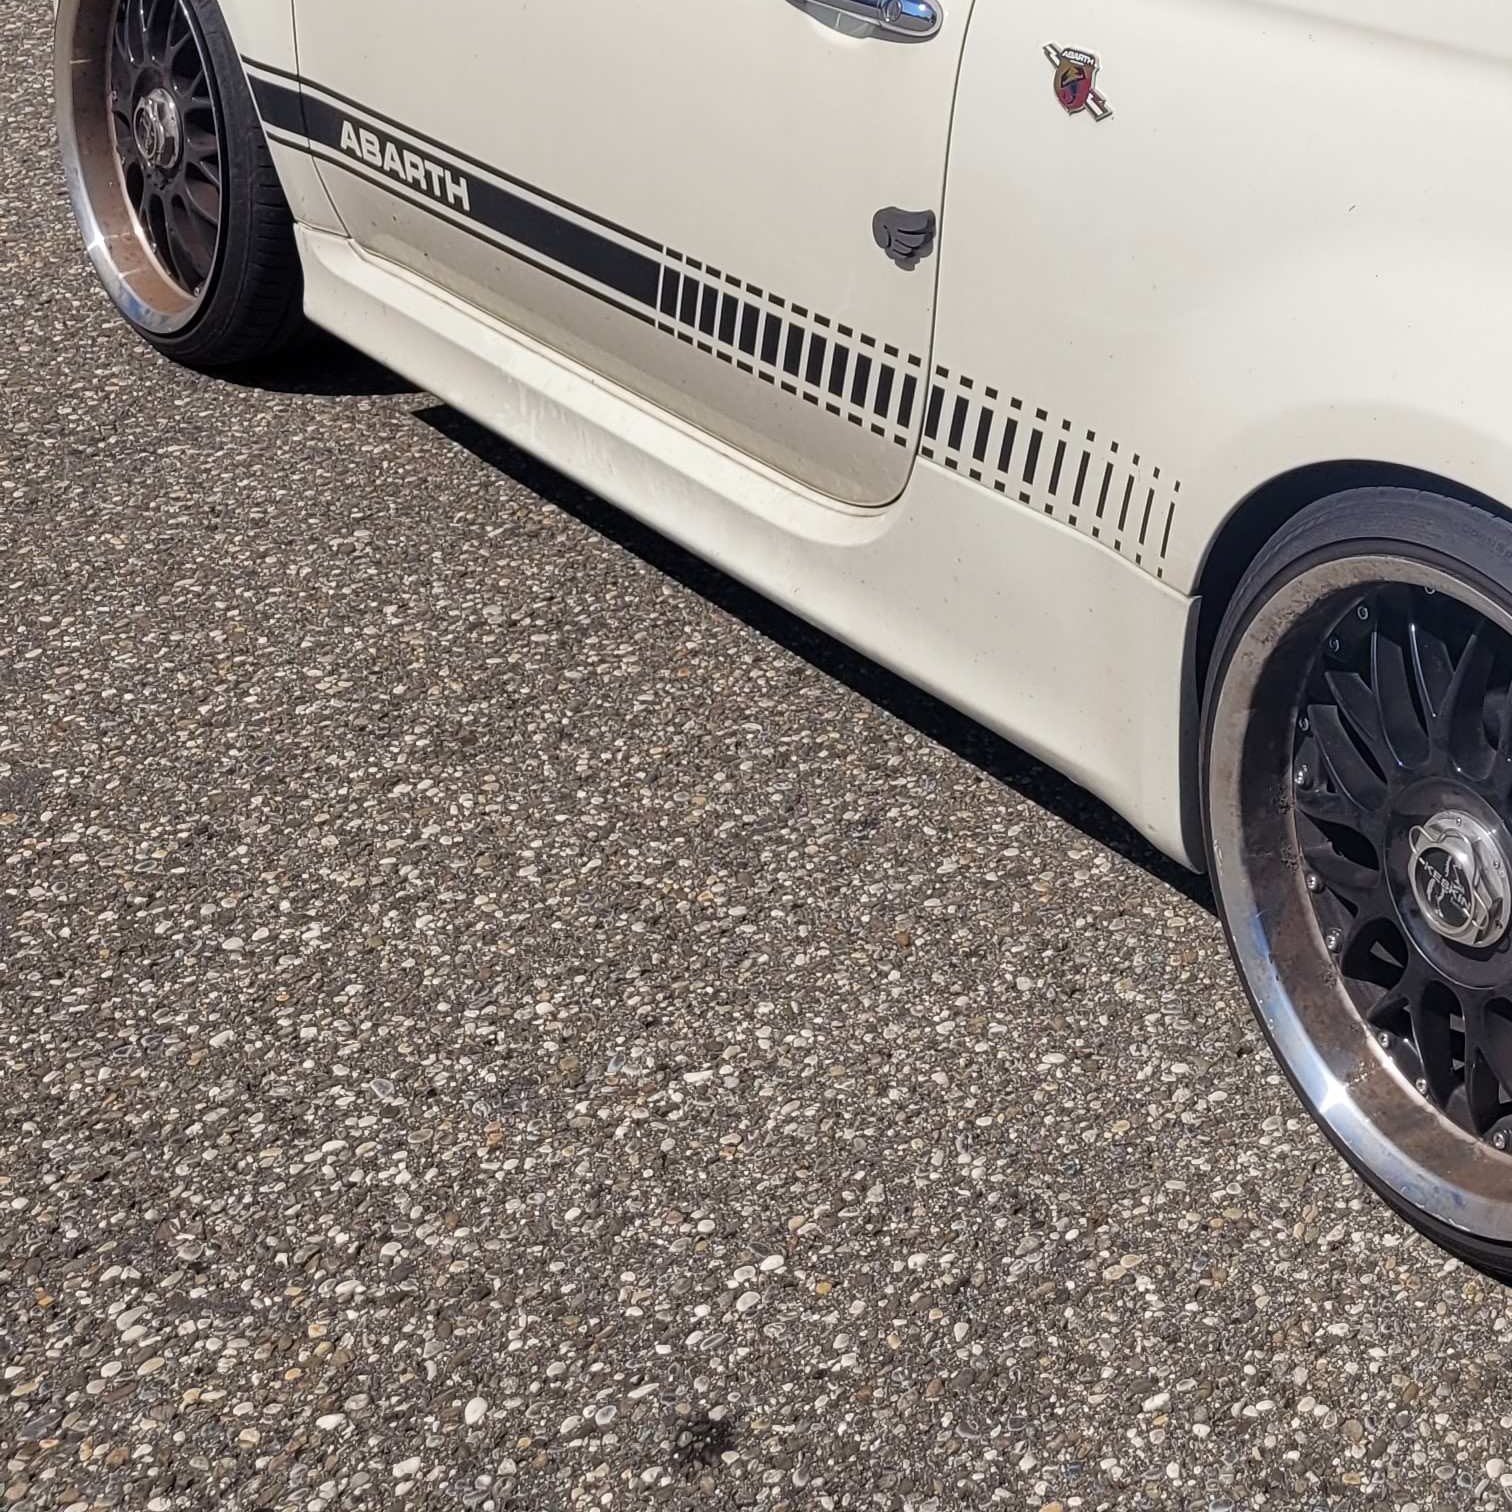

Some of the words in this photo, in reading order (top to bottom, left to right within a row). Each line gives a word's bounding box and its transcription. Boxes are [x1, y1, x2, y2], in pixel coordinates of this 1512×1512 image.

[1062, 50, 1094, 65] ABARTH
[340, 120, 470, 212] ABARTH
[1423, 860, 1471, 910] KESKIN
